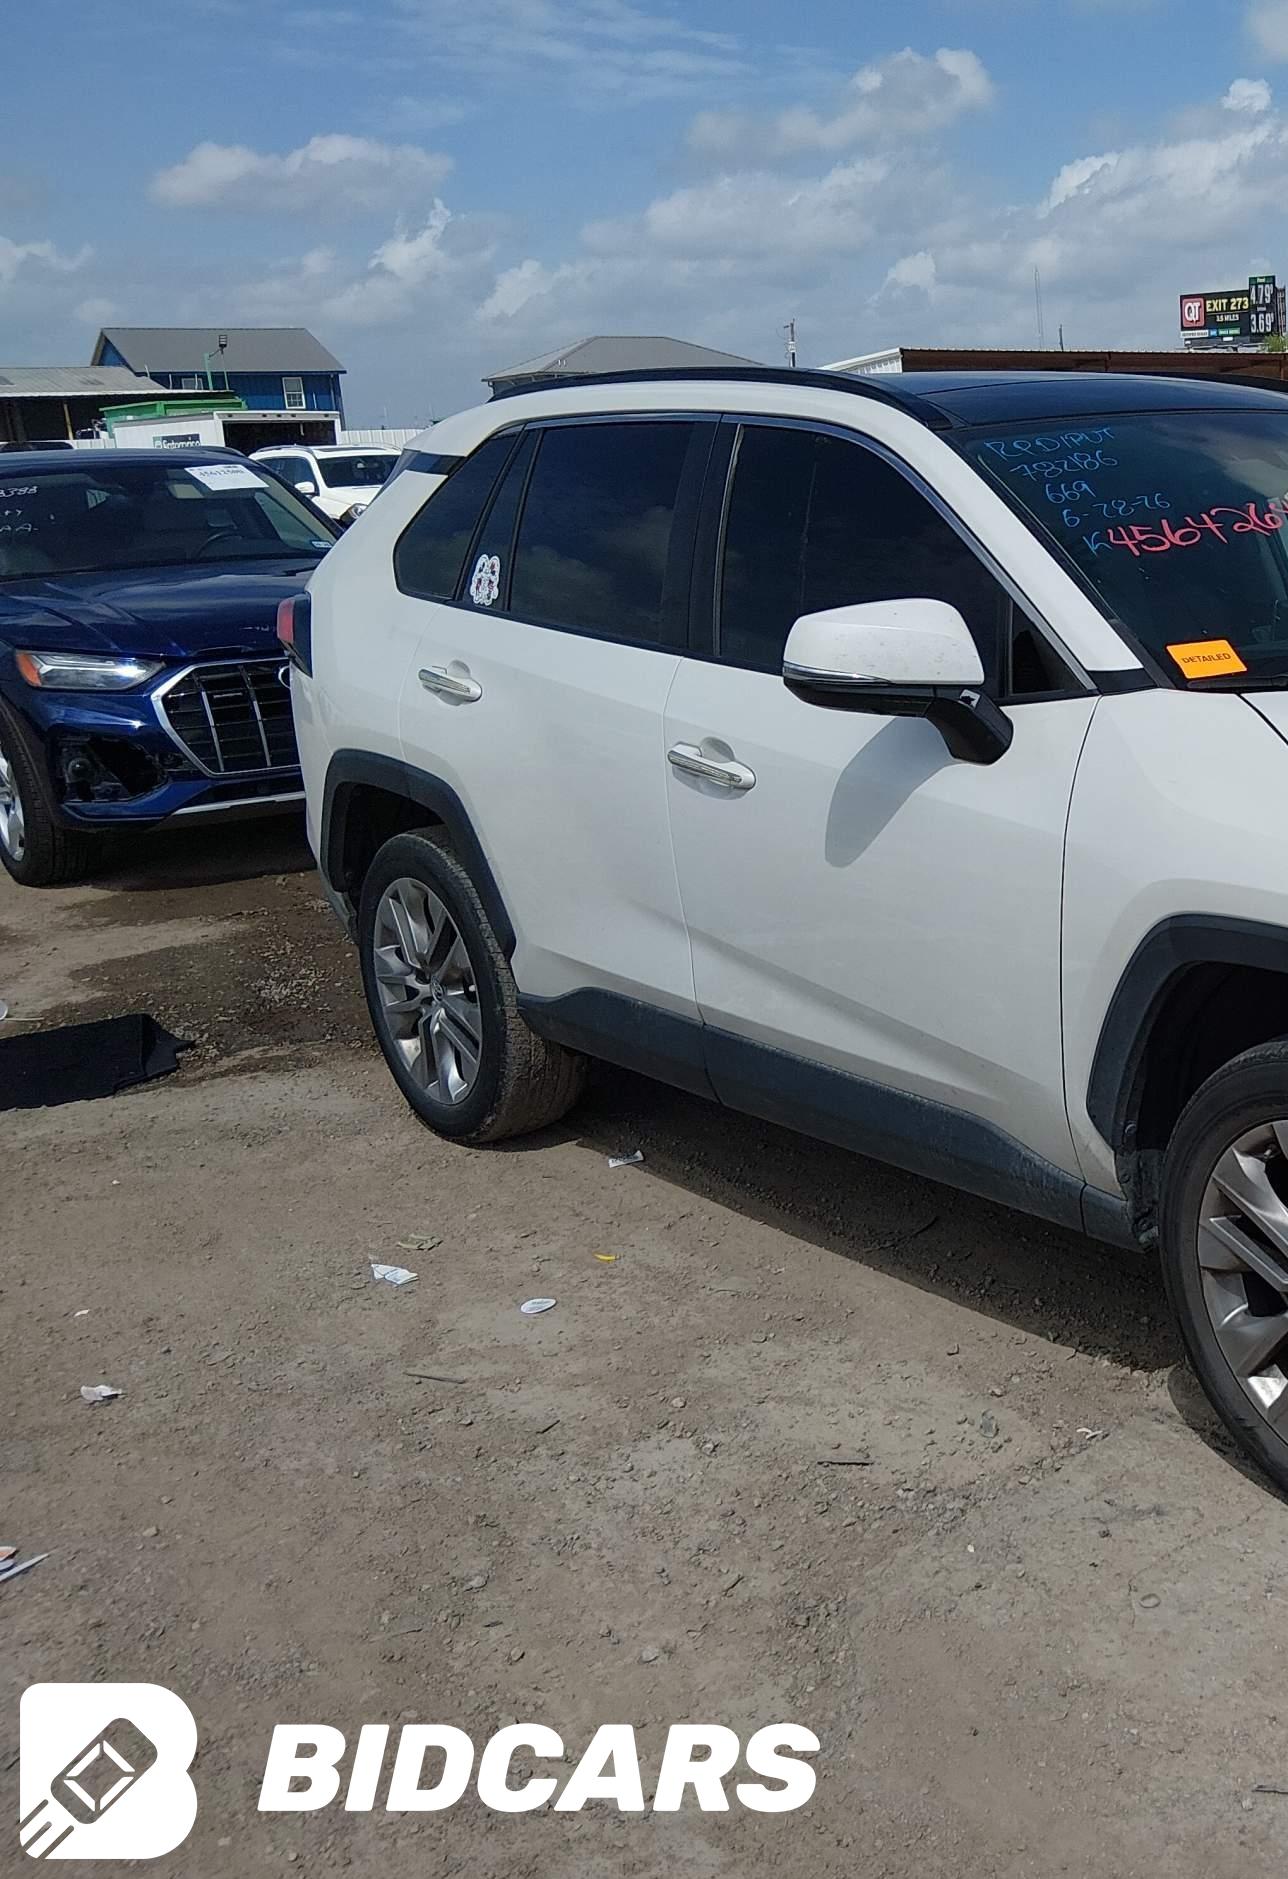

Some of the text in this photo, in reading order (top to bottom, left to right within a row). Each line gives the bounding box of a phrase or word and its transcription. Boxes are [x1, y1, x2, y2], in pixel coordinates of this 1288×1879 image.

[1184, 302, 1202, 322] QT
[1206, 297, 1249, 312] EXIT 273
[1046, 481, 1096, 503] 669
[1181, 652, 1232, 664] DETAILED
